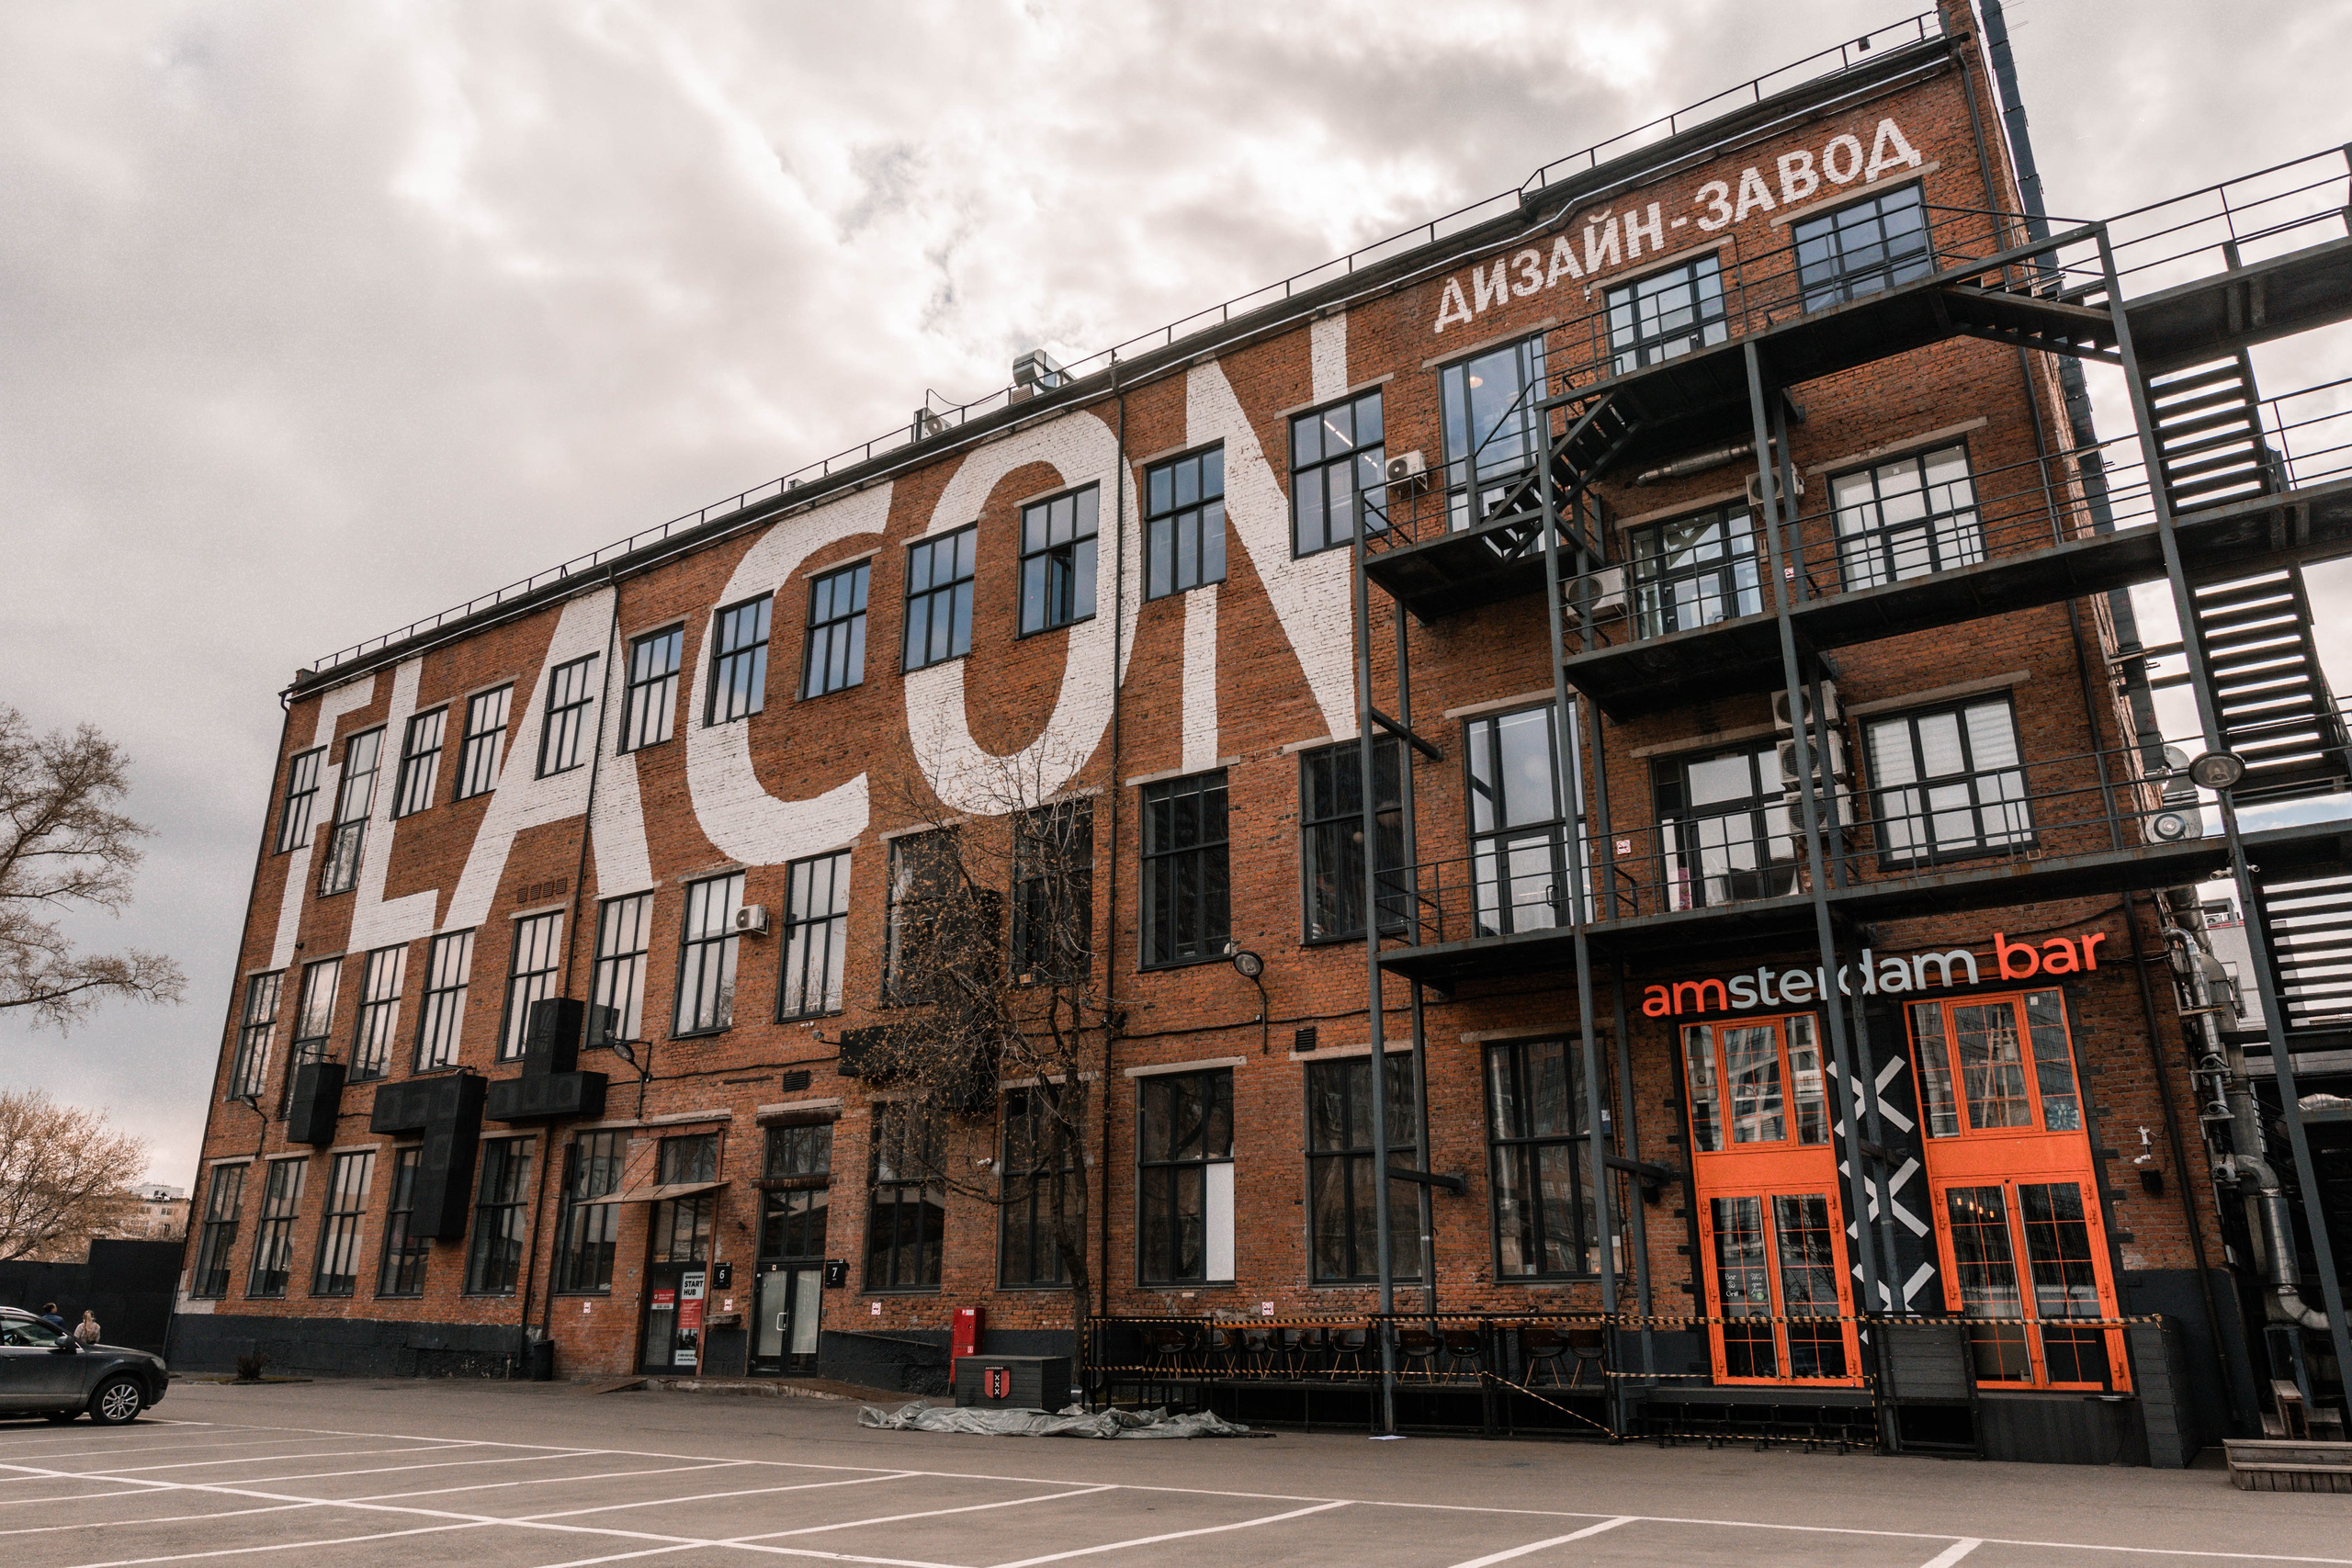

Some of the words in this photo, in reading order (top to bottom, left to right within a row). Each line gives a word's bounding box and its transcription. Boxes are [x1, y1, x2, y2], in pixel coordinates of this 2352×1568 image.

[1434, 118, 1923, 333] ДИЗАЙН-ЗАВОД
[269, 302, 1357, 970] FLACON
[1994, 932, 2106, 980] bar
[719, 1269, 725, 1280] 6
[832, 1267, 838, 1278] 7
